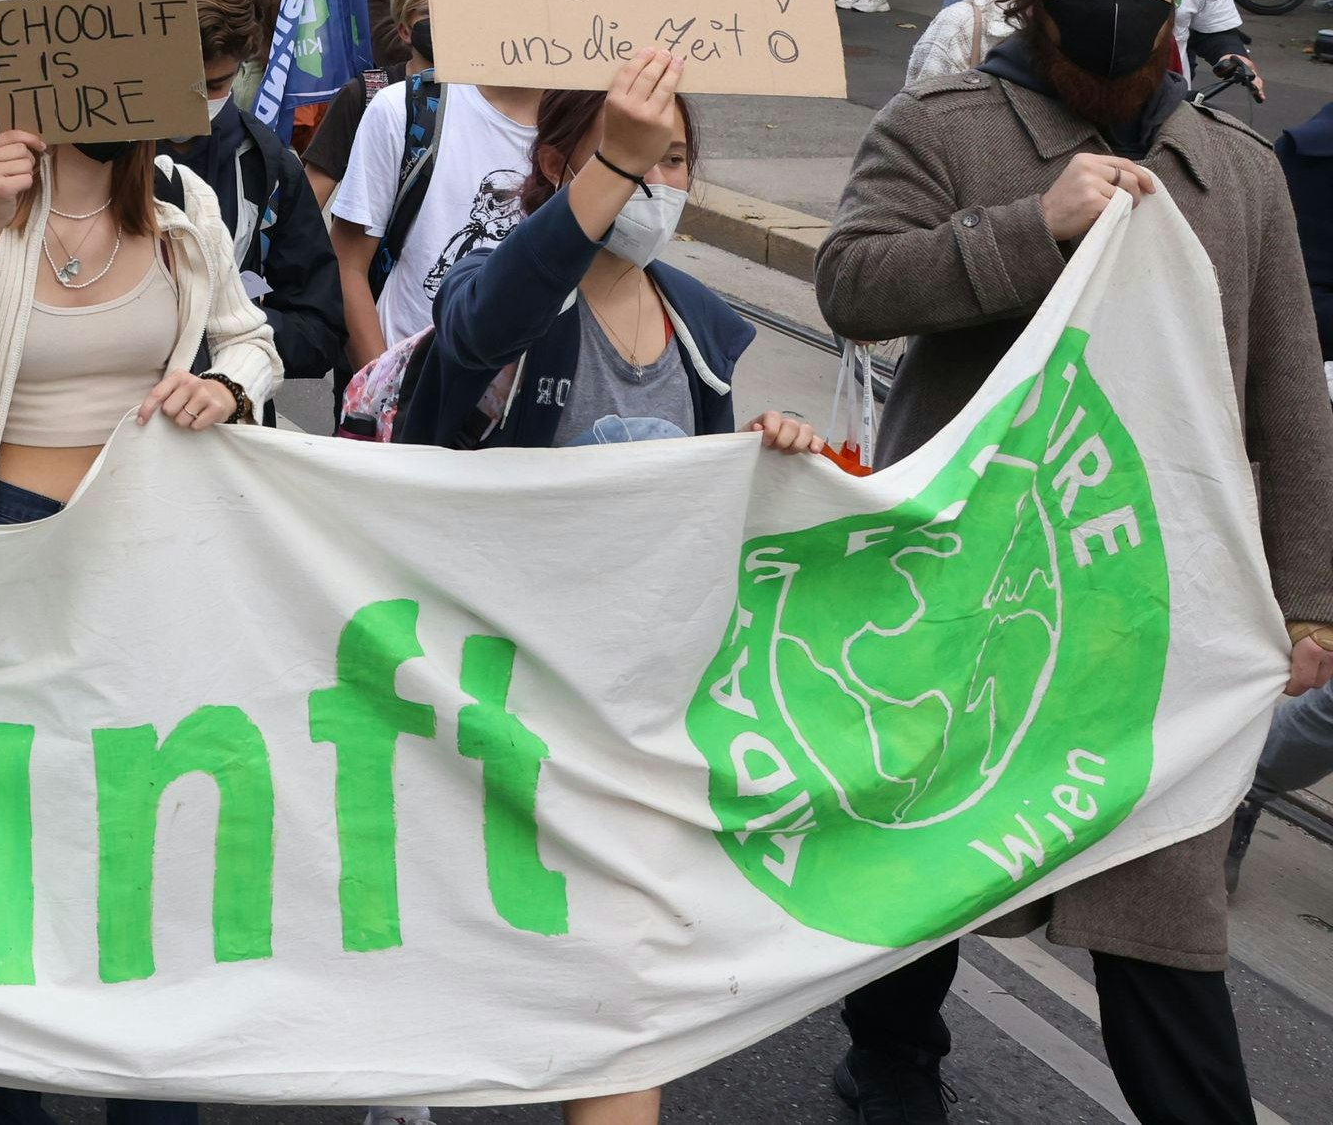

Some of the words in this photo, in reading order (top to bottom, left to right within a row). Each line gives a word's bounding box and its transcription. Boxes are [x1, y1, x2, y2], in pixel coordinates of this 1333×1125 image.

[138, 0, 188, 35] IF
[501, 34, 572, 66] uns
[583, 14, 632, 63] die
[655, 13, 745, 63] Zeit
[40, 51, 79, 81] IS
[967, 746, 1106, 882] Wien
